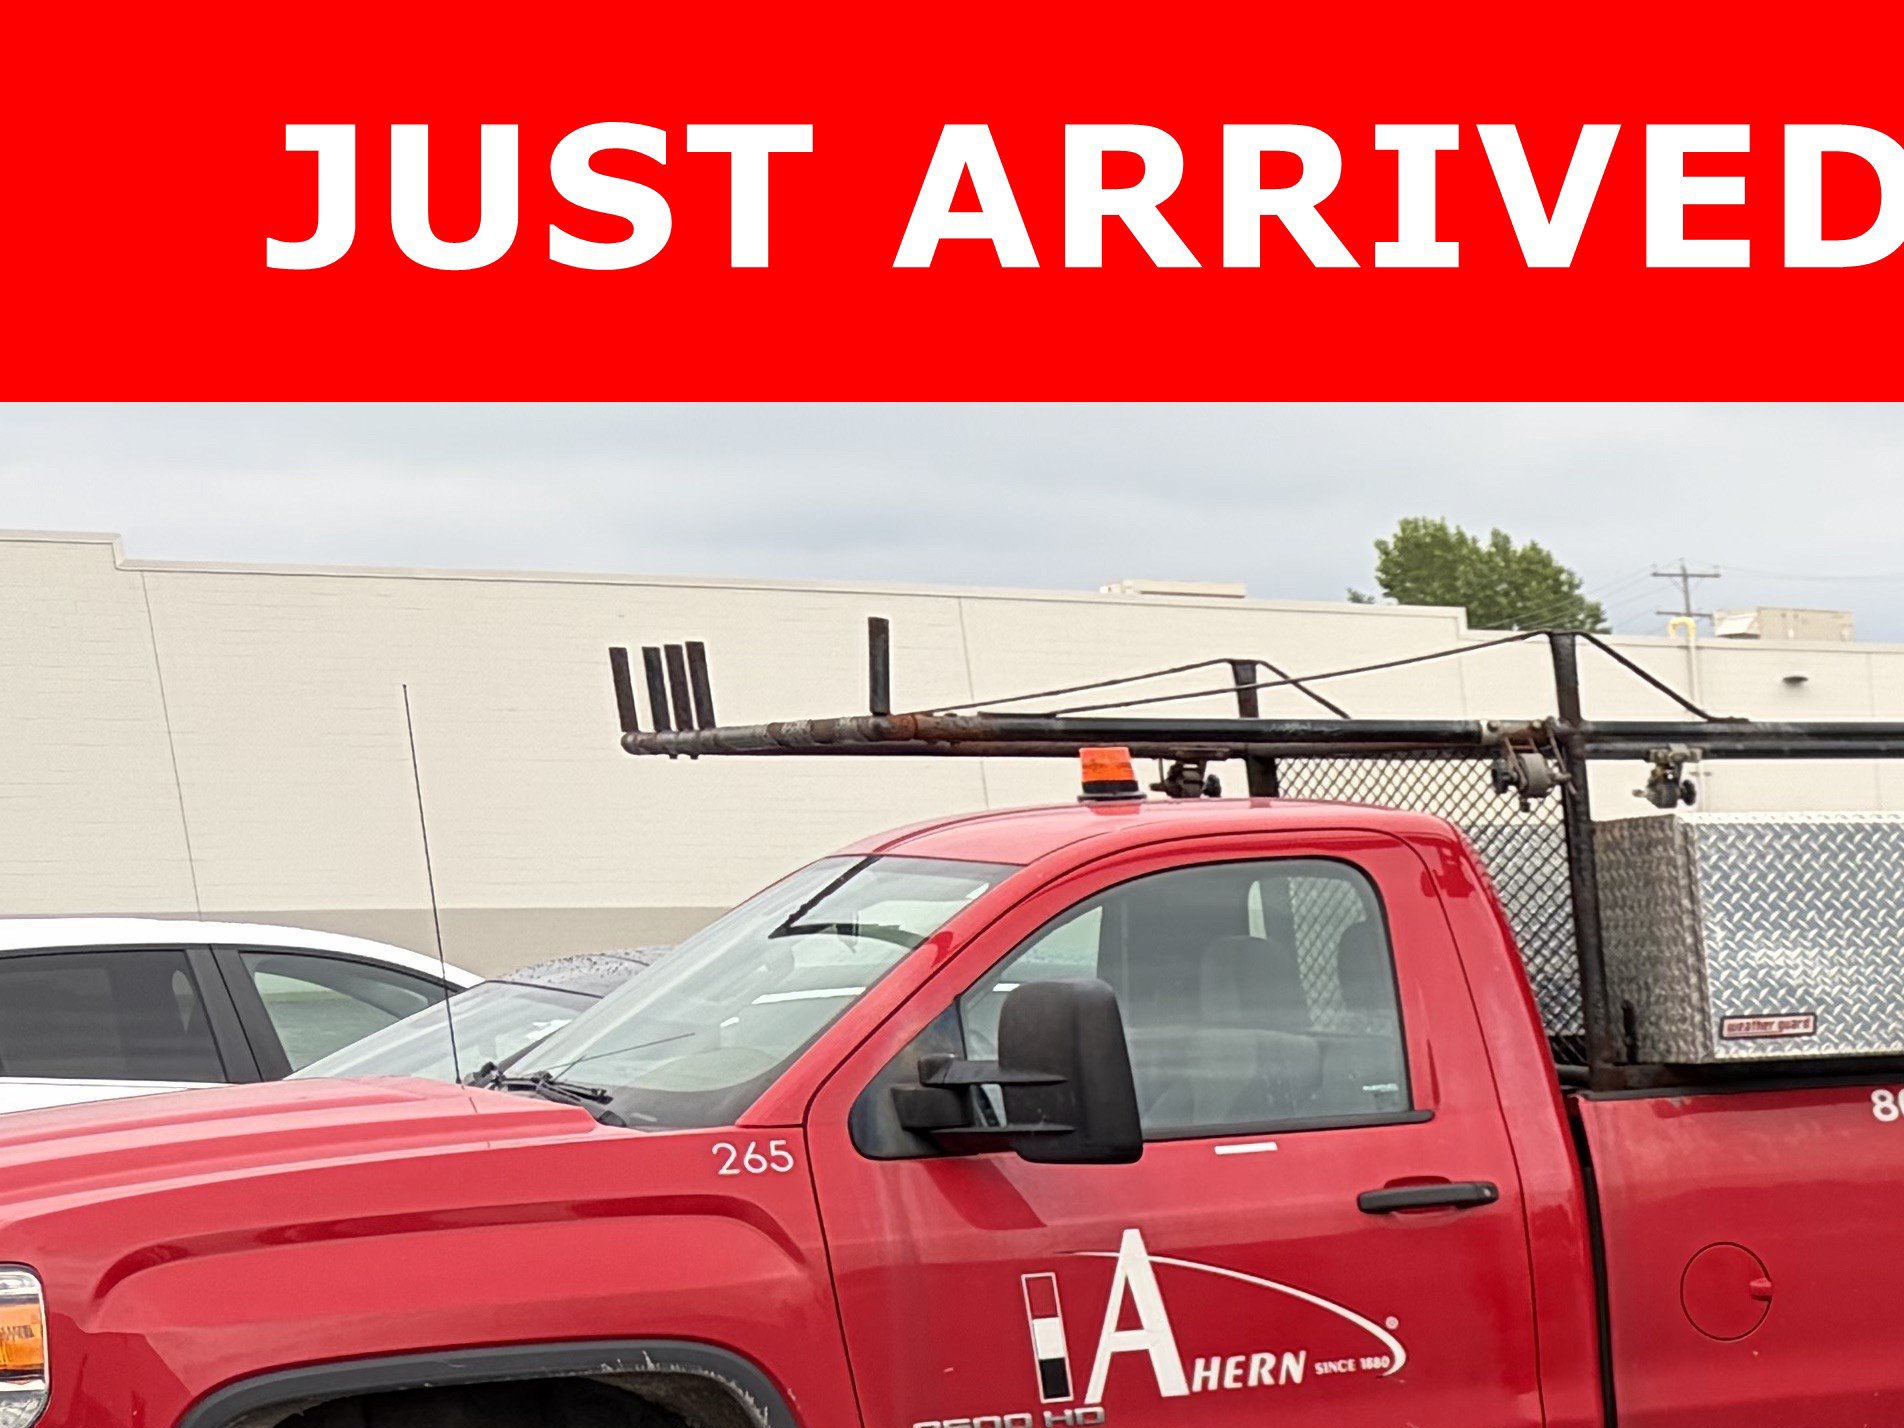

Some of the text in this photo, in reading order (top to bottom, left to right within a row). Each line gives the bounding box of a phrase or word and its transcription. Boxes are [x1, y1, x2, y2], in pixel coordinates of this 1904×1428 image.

[711, 1139, 794, 1175] 265
[1314, 1358, 1357, 1375] SINCE
[1043, 1407, 1106, 1428] HD
